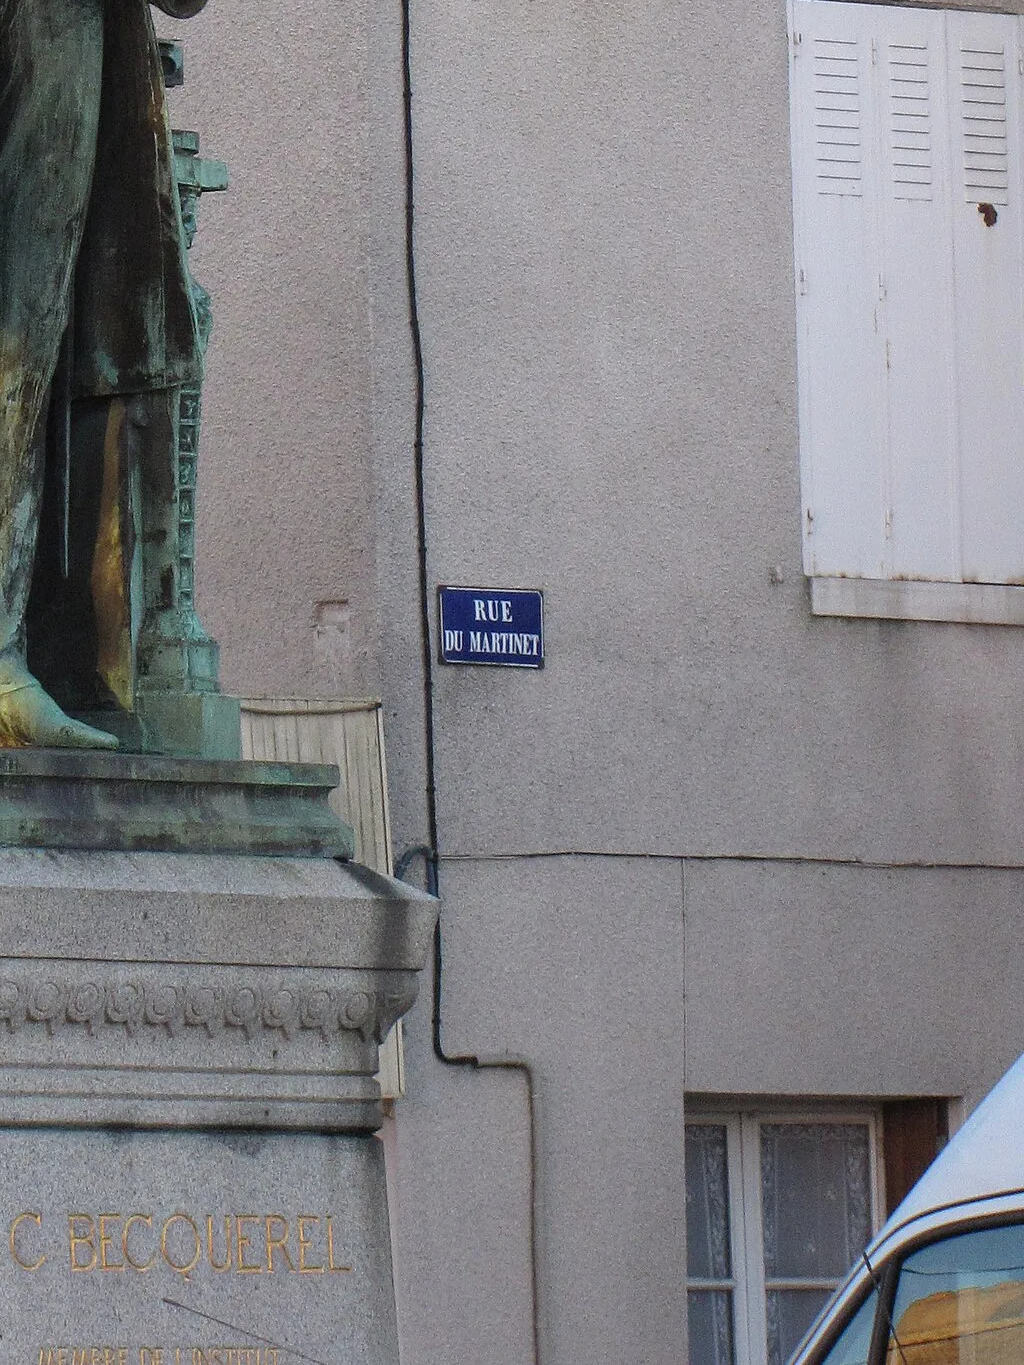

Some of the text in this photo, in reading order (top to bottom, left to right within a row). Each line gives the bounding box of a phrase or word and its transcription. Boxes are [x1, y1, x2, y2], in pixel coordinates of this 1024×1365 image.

[473, 599, 513, 623] RUE
[444, 630, 539, 656] DU MARTINET
[9, 1211, 46, 1272] C
[68, 1211, 352, 1282] BECQUEREL
